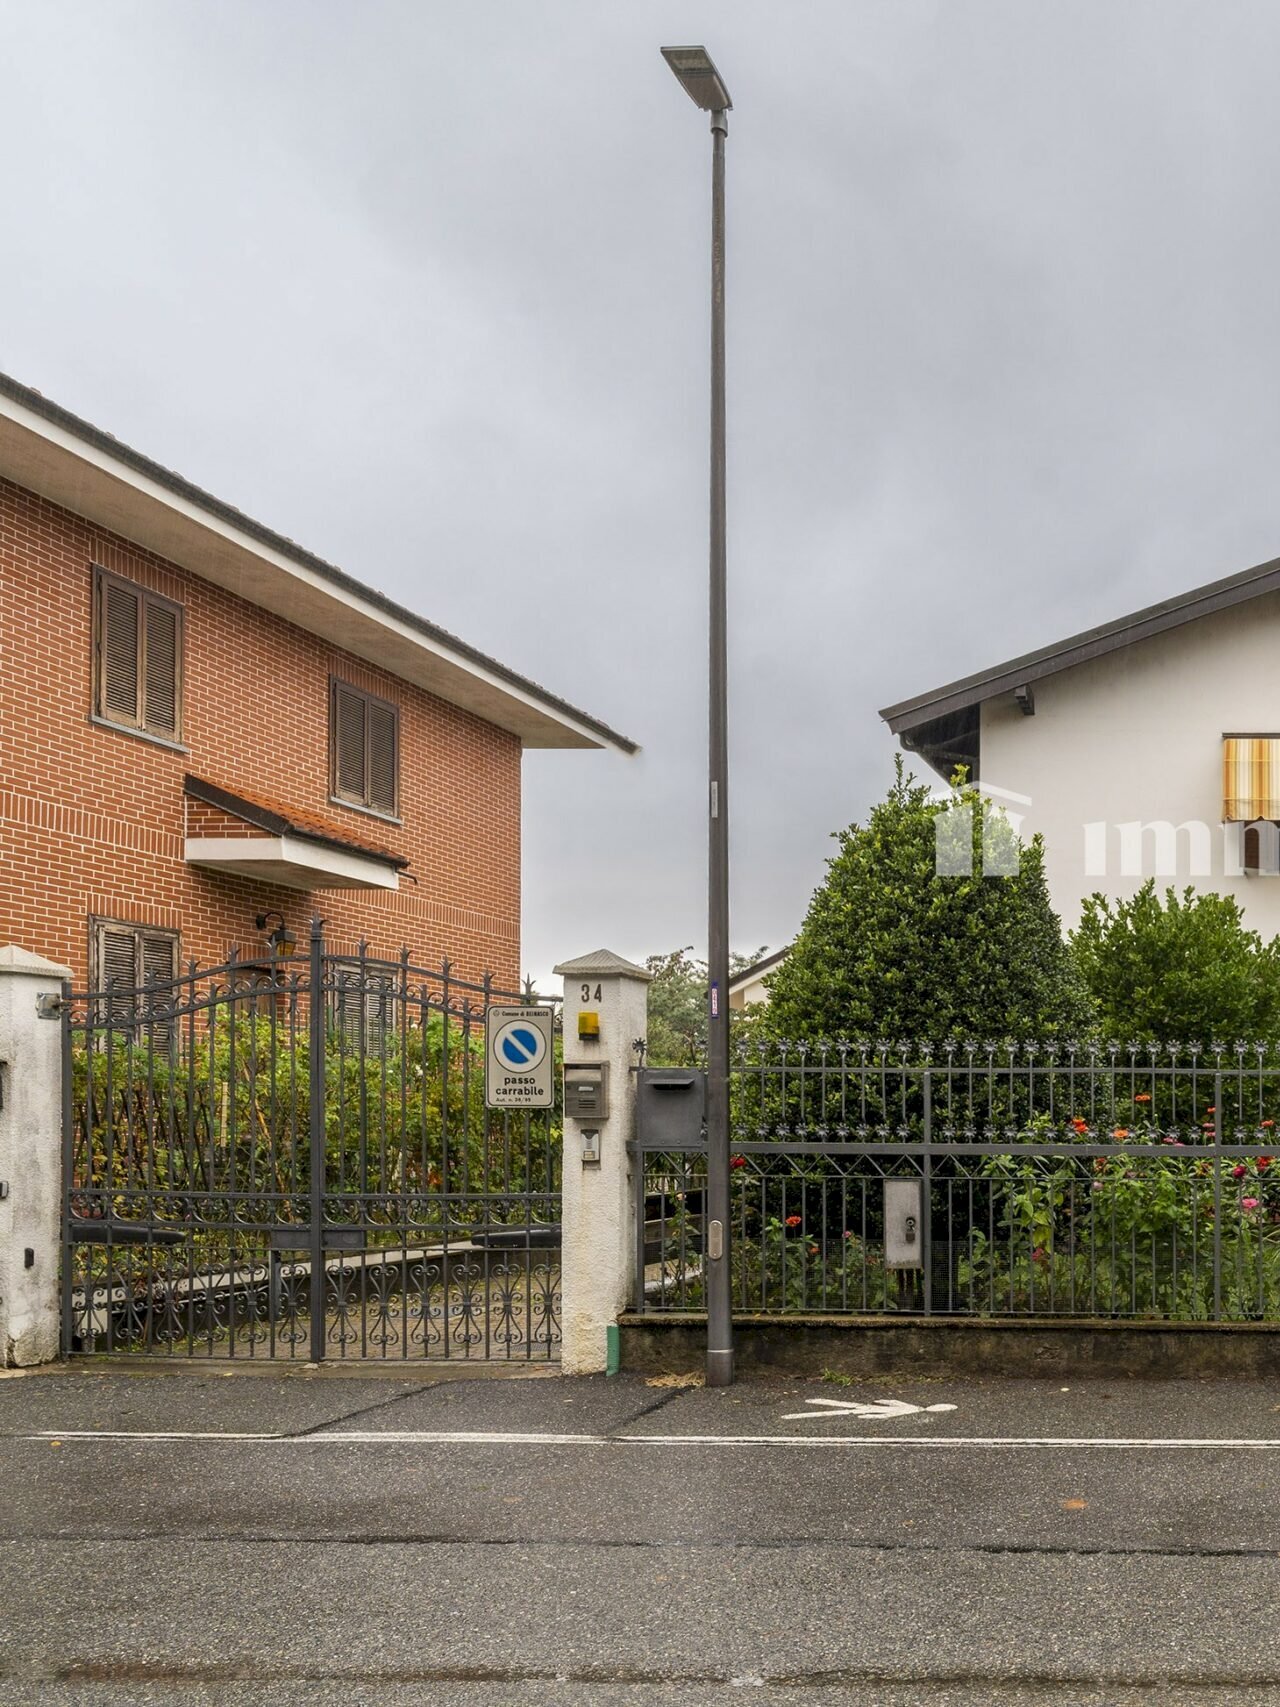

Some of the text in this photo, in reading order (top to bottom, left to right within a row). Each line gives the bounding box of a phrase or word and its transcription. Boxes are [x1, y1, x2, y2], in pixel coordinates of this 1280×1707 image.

[581, 984, 602, 1002] 34
[504, 1077, 536, 1086] passo
[495, 1086, 544, 1096] carrabile
